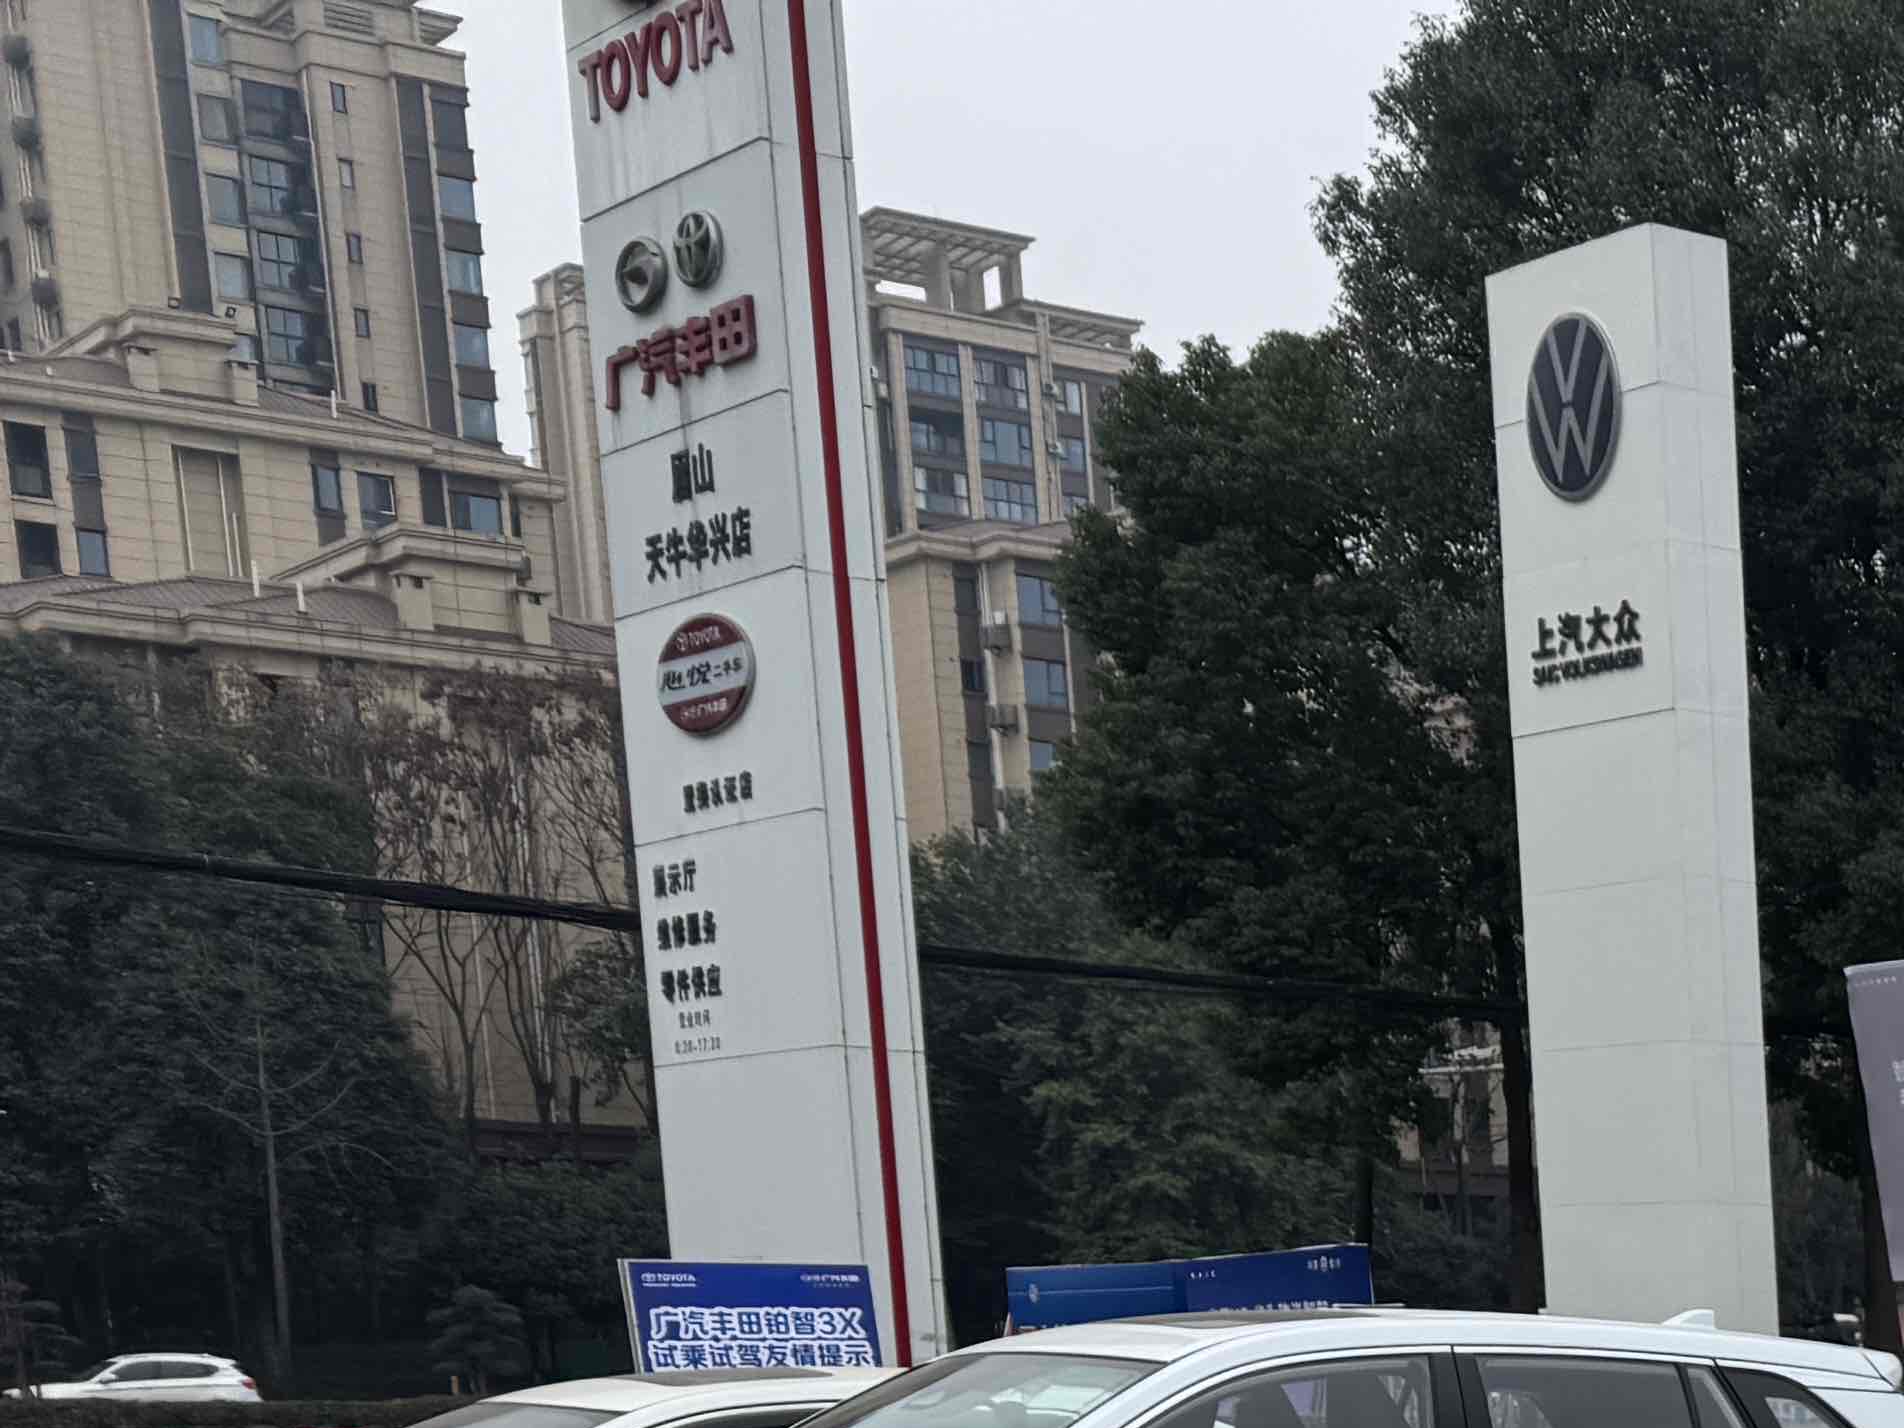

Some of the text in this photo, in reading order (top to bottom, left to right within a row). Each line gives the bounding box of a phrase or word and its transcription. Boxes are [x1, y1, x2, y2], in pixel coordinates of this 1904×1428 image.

[578, 0, 735, 124] TOYOTA
[602, 293, 758, 411] 广汽丰田
[645, 505, 753, 585] 天牛华兴店
[1531, 599, 1642, 660] 上汽大众
[648, 1340, 875, 1371] 试乘试驾友情提示
[650, 1307, 866, 1341] 广汽丰田铂智3X
